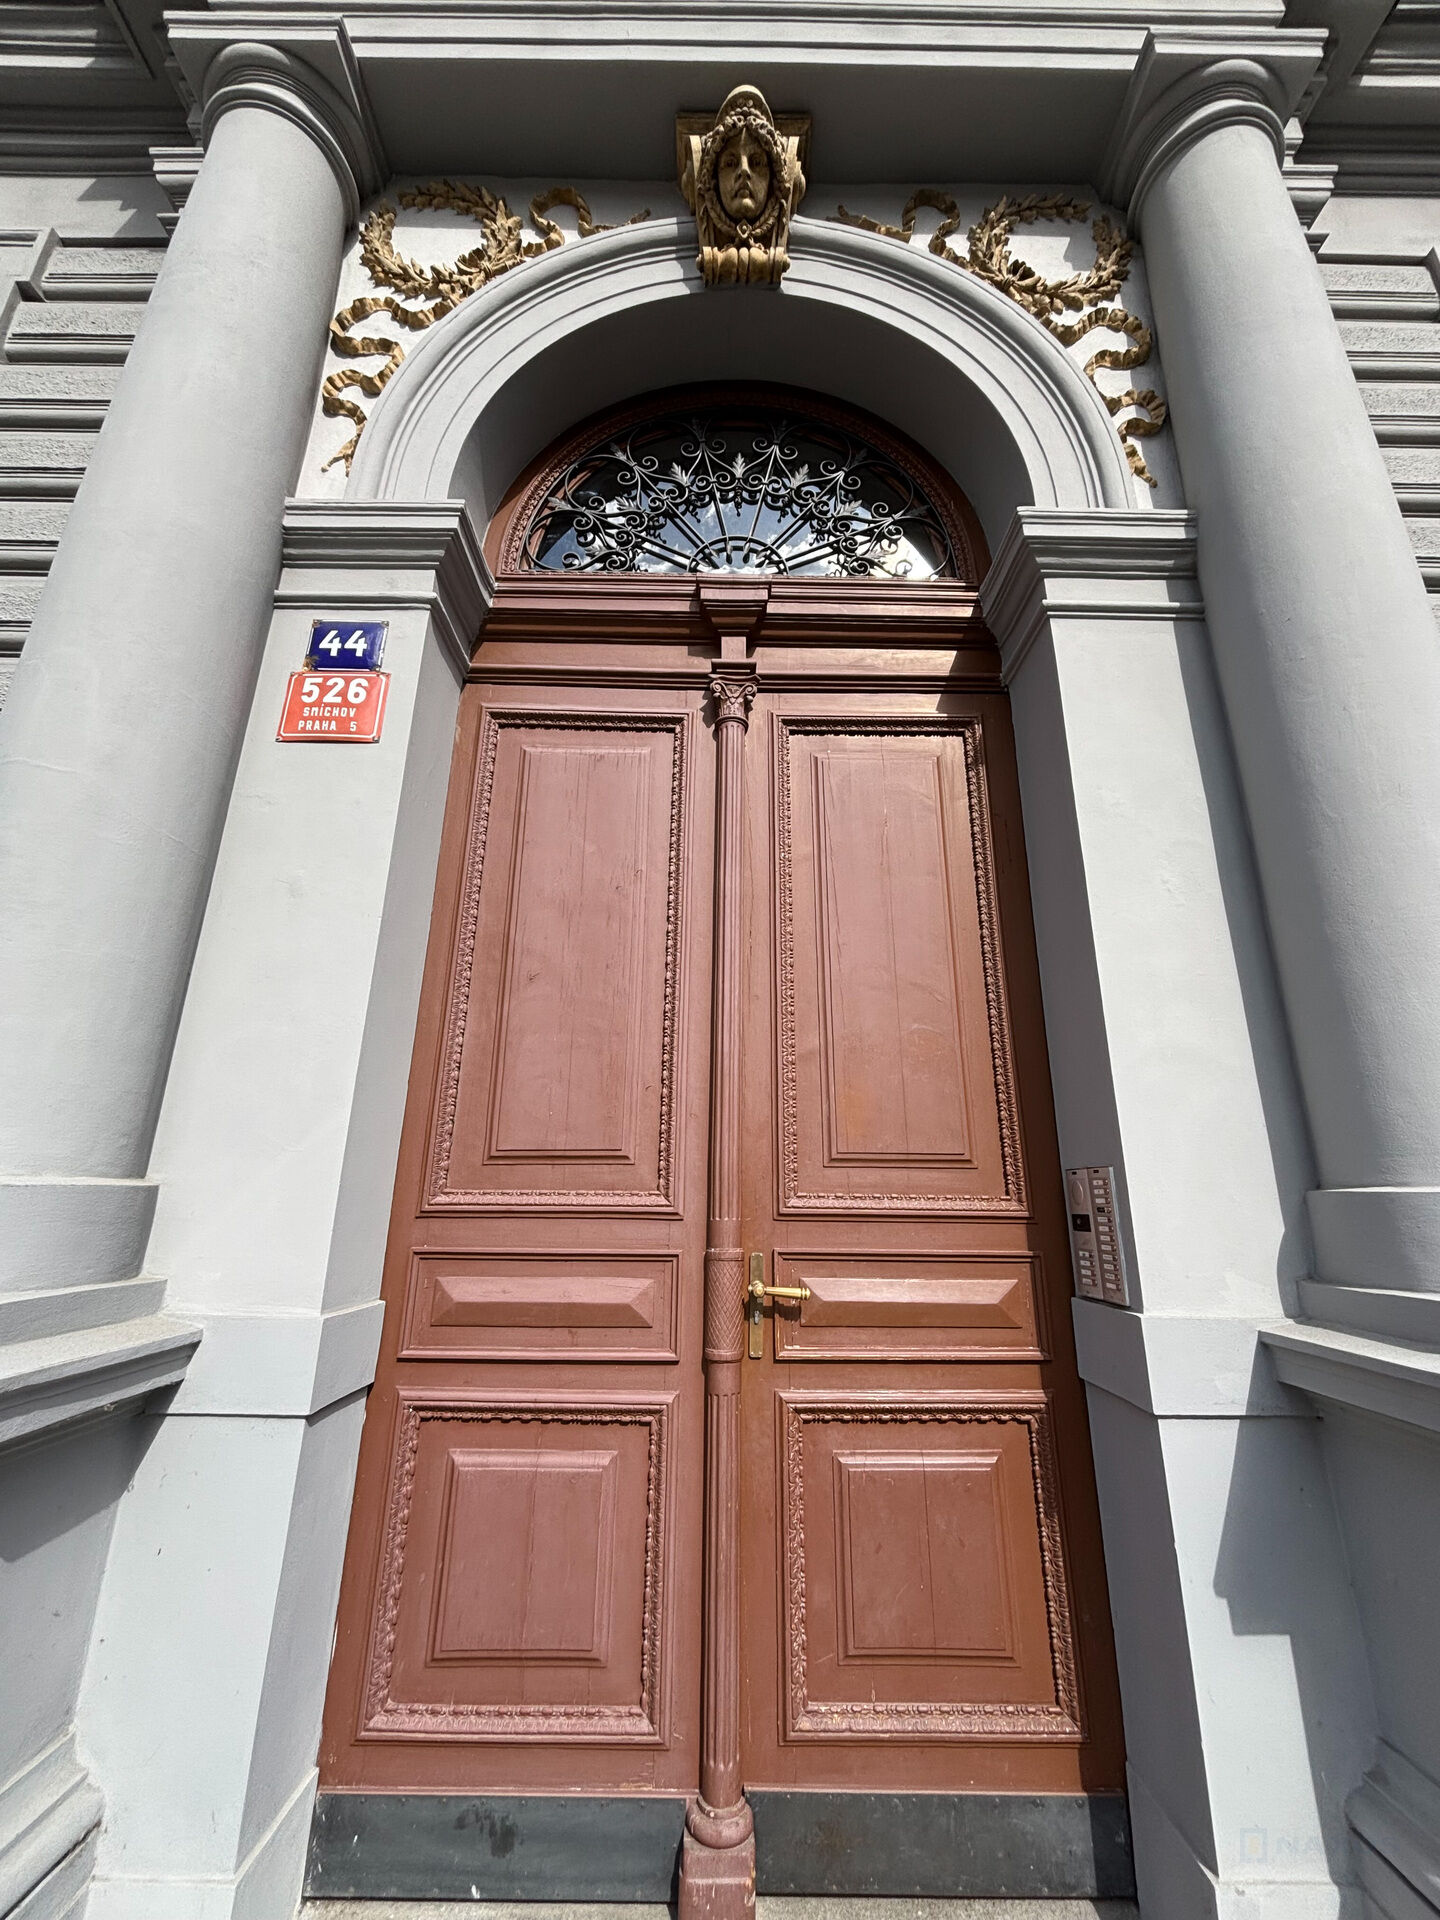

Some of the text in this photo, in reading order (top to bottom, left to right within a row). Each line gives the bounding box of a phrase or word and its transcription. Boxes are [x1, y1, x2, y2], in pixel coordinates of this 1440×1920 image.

[318, 630, 368, 657] 44
[300, 677, 369, 704] 526
[297, 720, 357, 731] PRAHA 5
